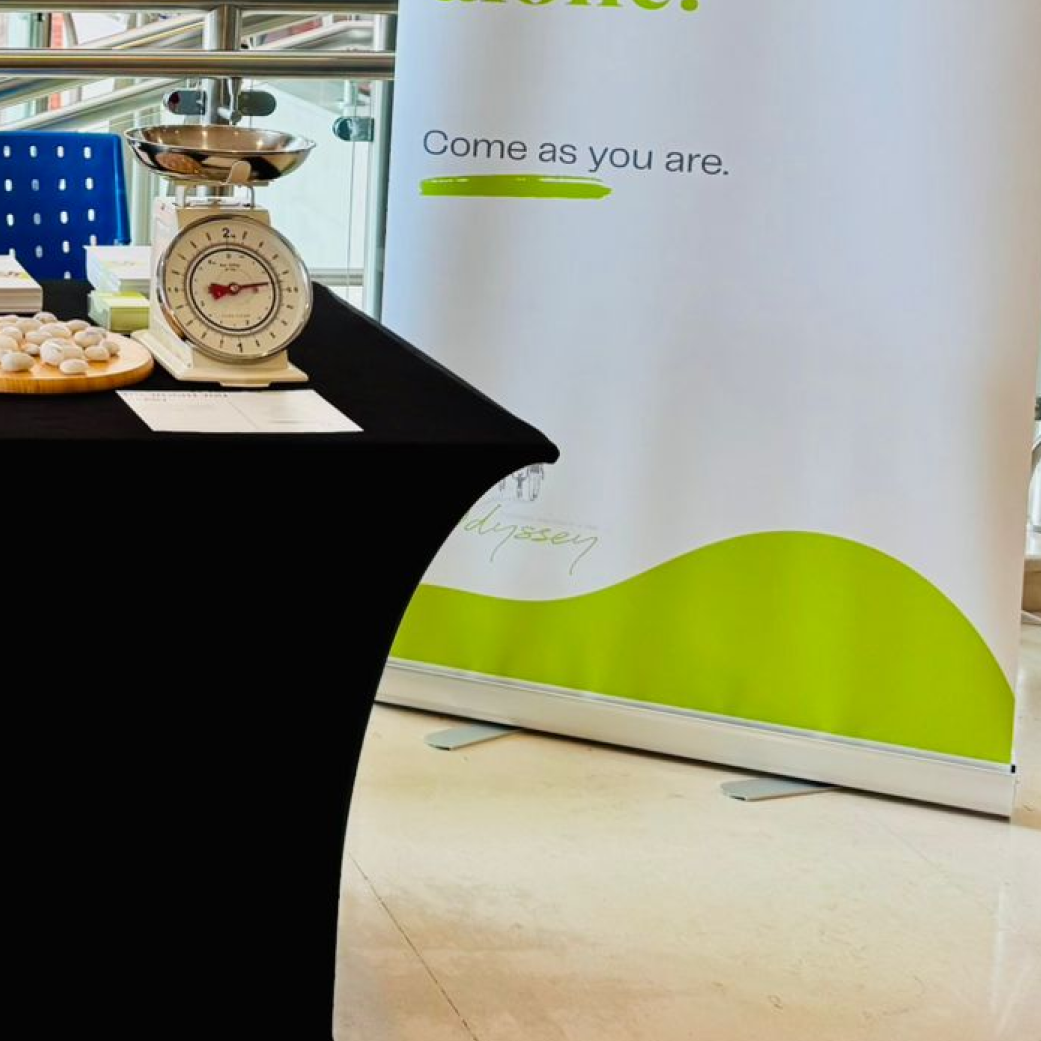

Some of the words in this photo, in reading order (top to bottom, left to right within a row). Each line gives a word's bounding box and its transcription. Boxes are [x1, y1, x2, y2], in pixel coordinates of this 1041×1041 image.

[423, 130, 527, 160] Come
[539, 142, 577, 164] as
[588, 145, 653, 173] you
[665, 151, 729, 175] are.
[464, 503, 598, 576] dyssey
